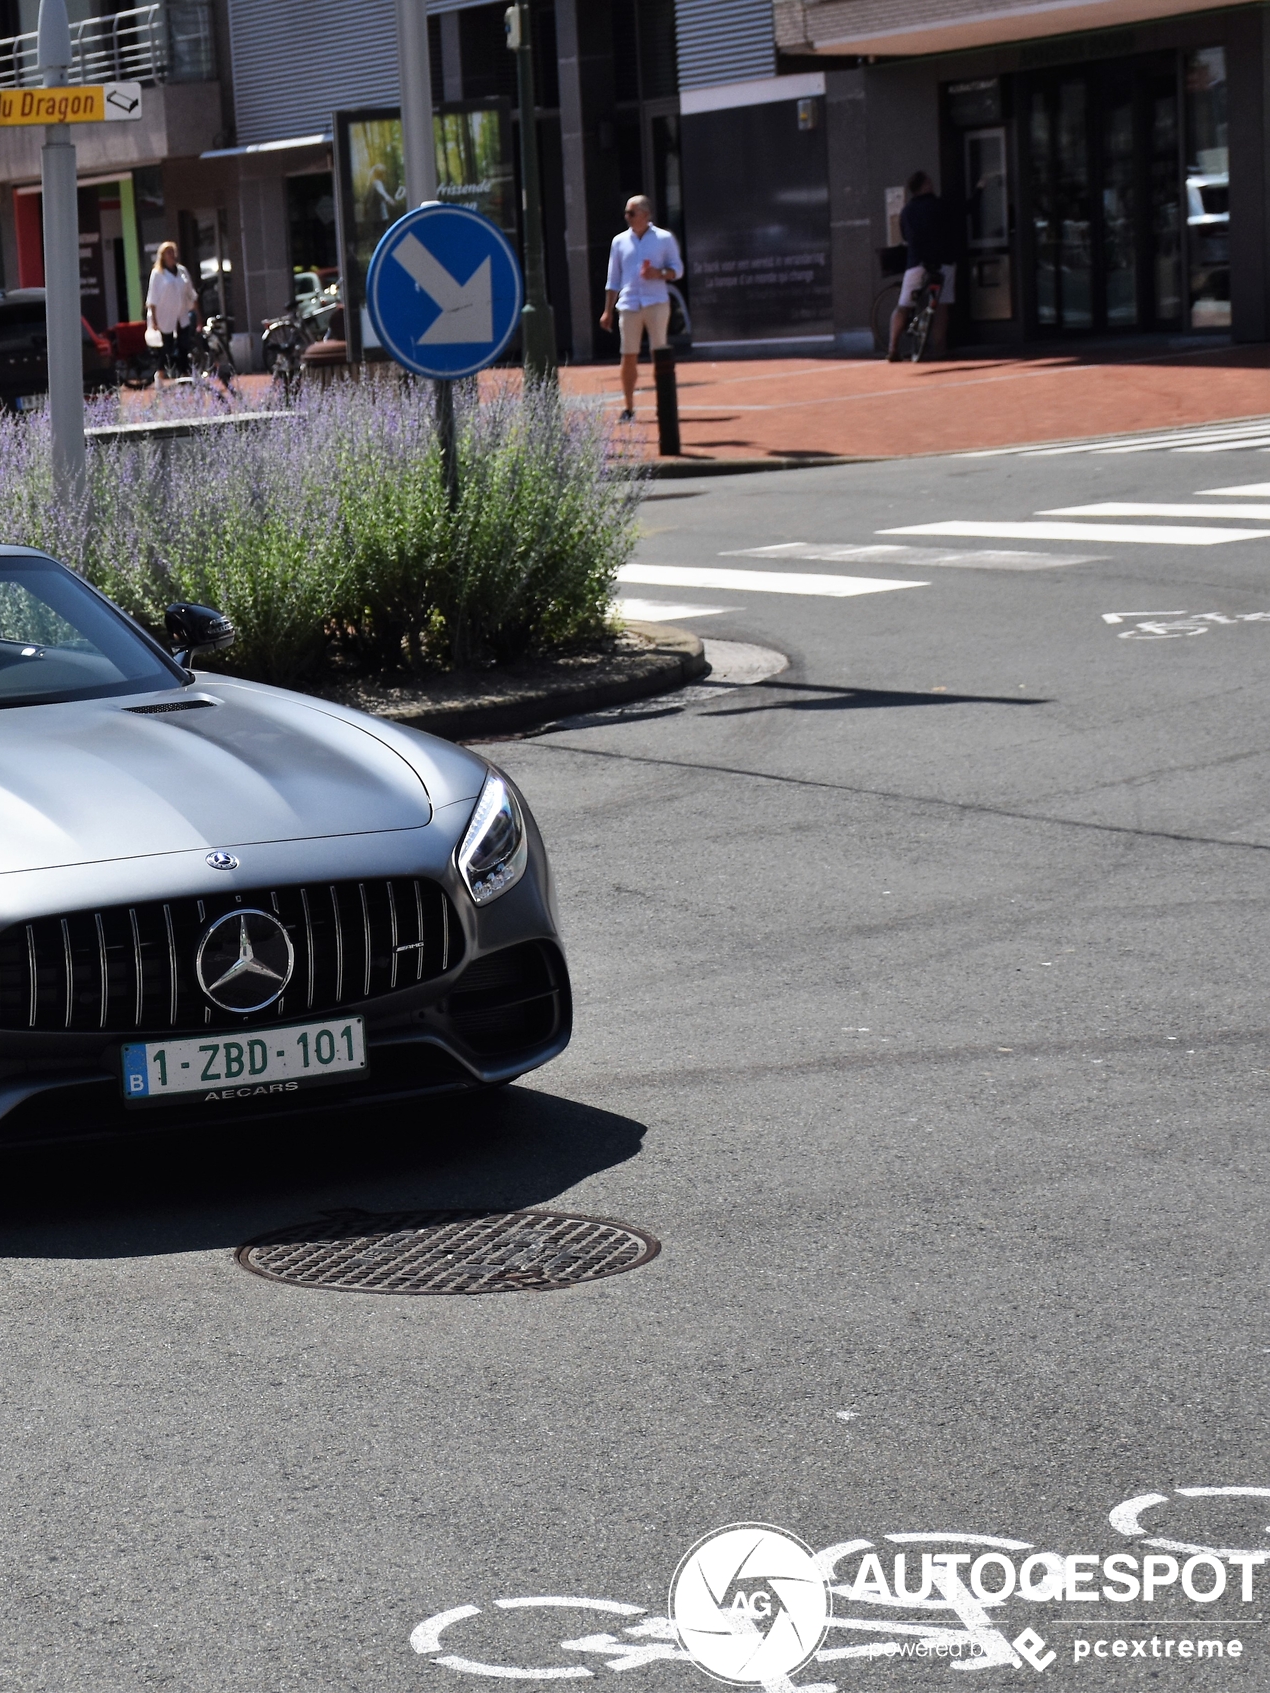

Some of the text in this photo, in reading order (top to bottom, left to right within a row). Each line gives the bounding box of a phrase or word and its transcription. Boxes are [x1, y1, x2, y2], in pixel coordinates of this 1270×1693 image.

[21, 91, 95, 123] Dragon
[130, 1075, 144, 1092] B
[204, 1081, 299, 1101] AECARS
